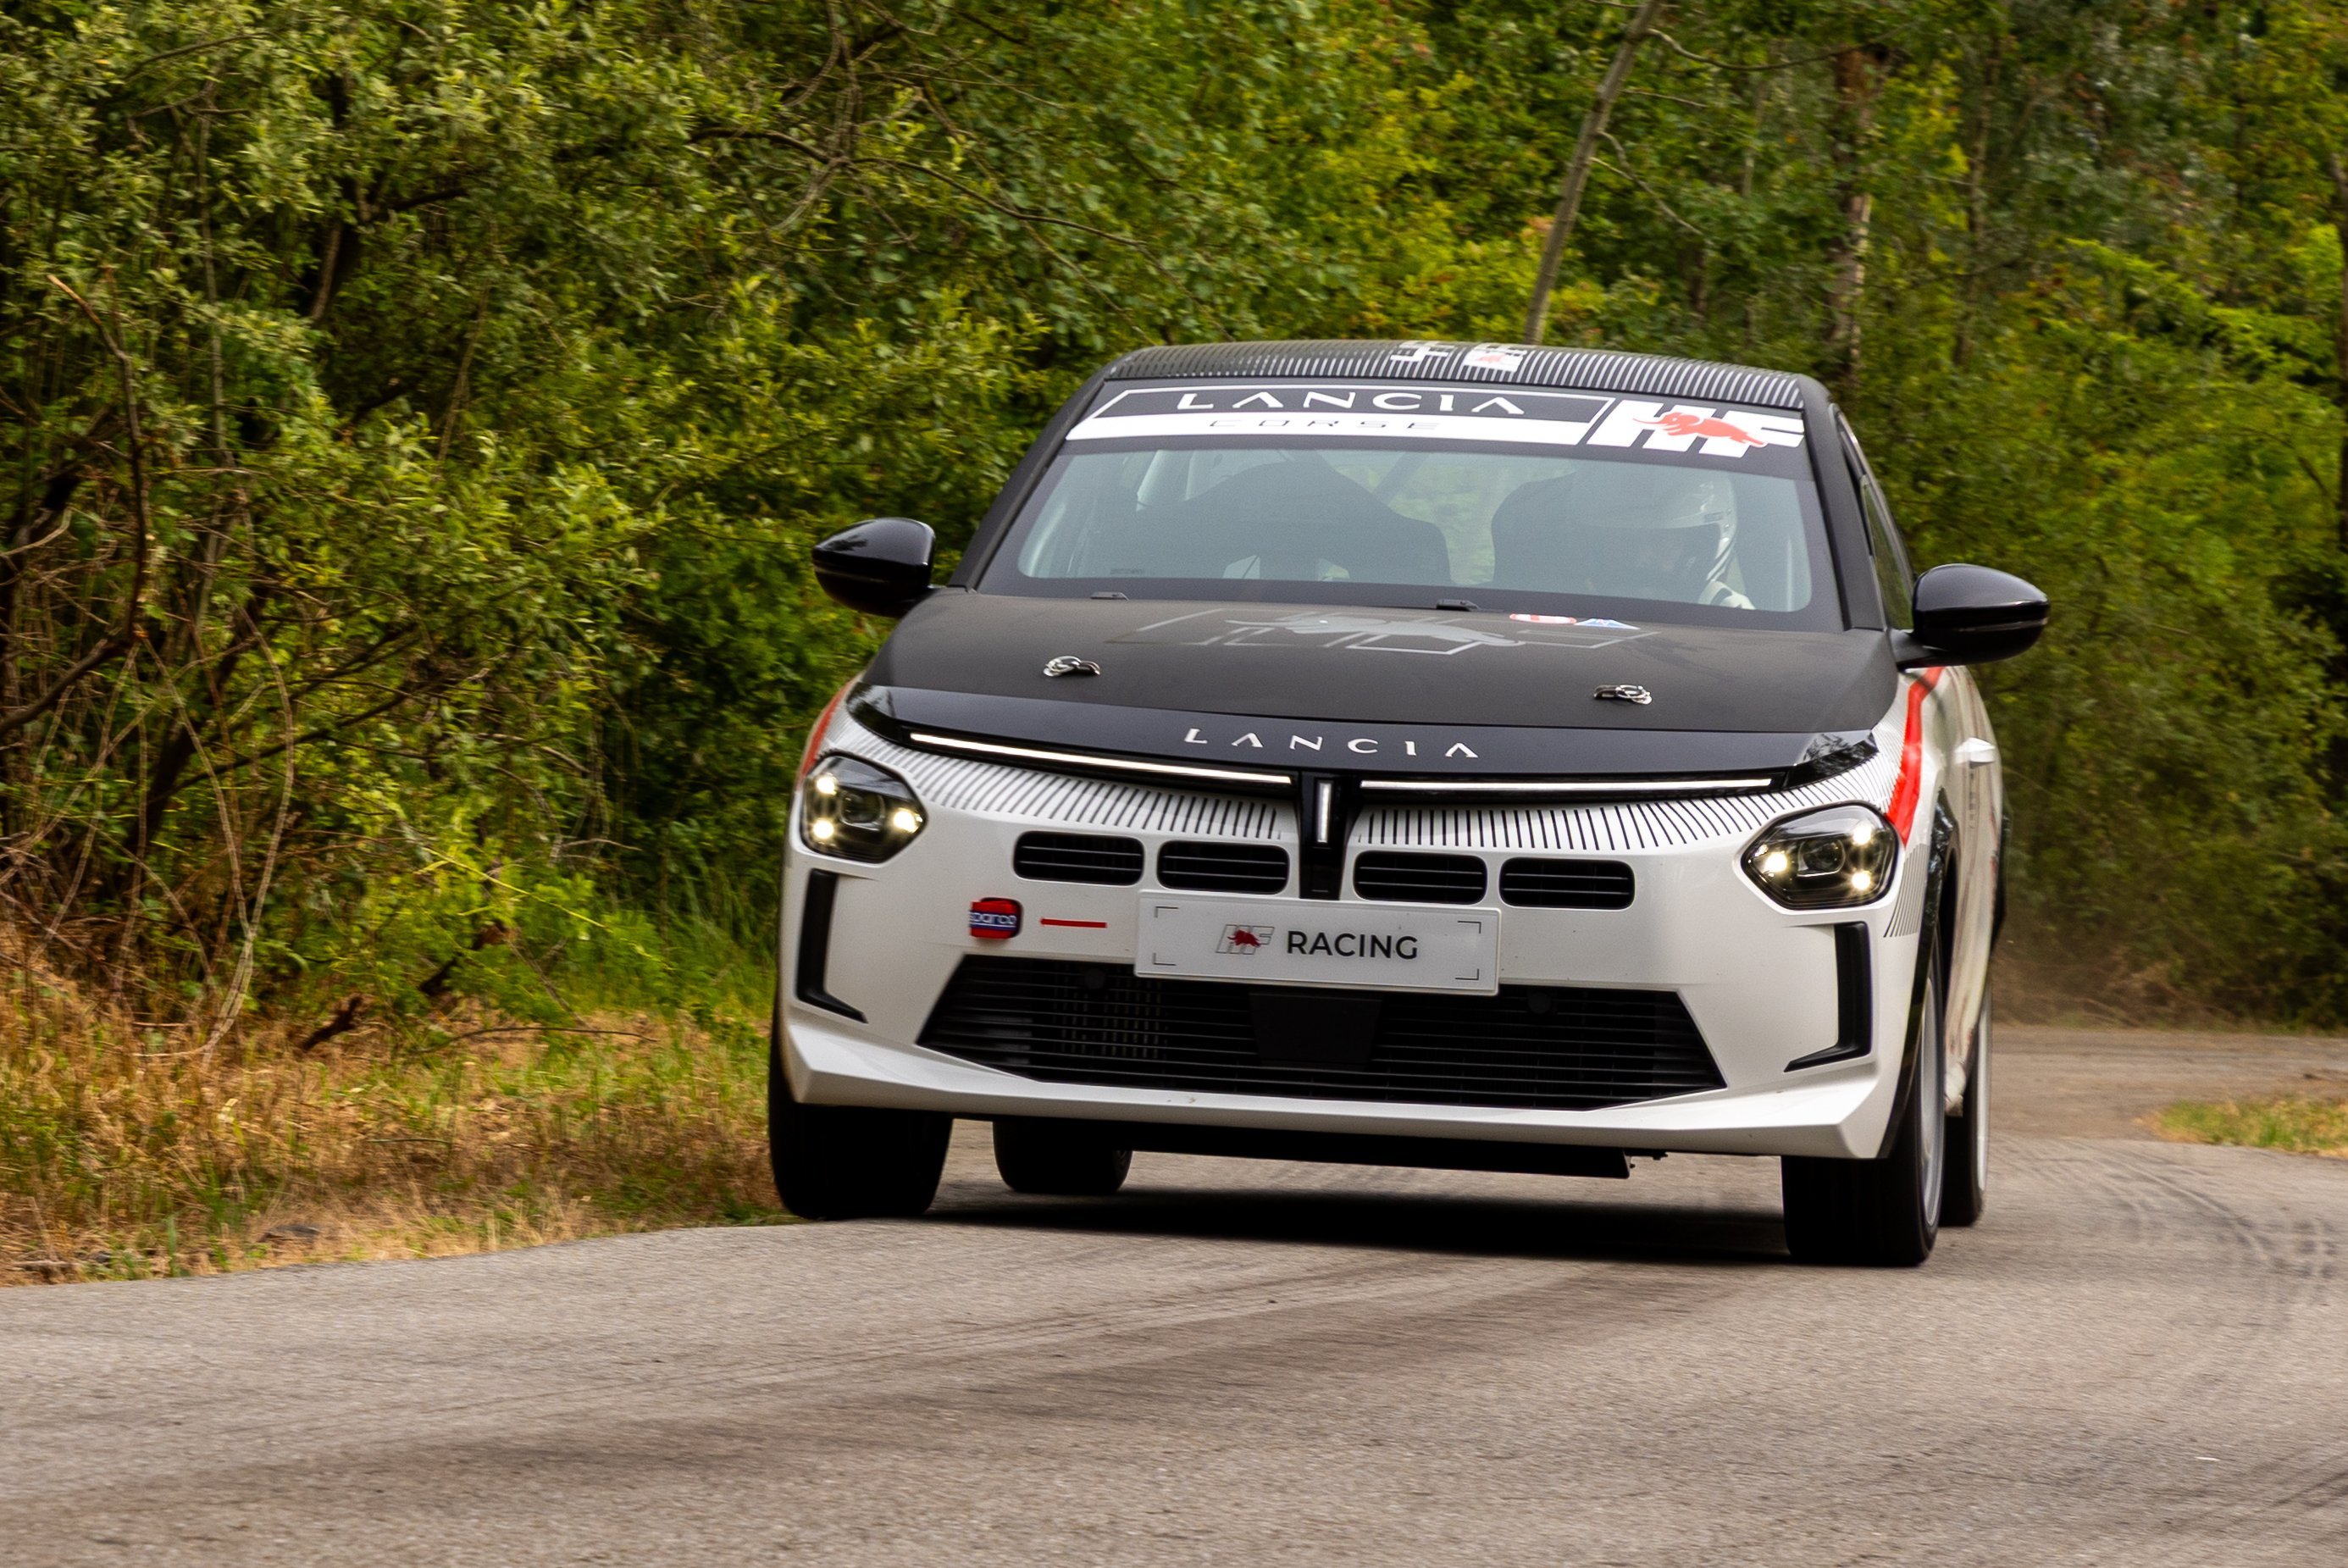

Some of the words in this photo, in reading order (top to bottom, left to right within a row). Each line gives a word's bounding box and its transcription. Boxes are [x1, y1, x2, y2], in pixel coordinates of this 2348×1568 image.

[1177, 391, 1525, 415] LANCIA
[1209, 419, 1439, 430] CORSE
[1184, 729, 1479, 759] LANCIA
[1287, 930, 1419, 960] RACING
